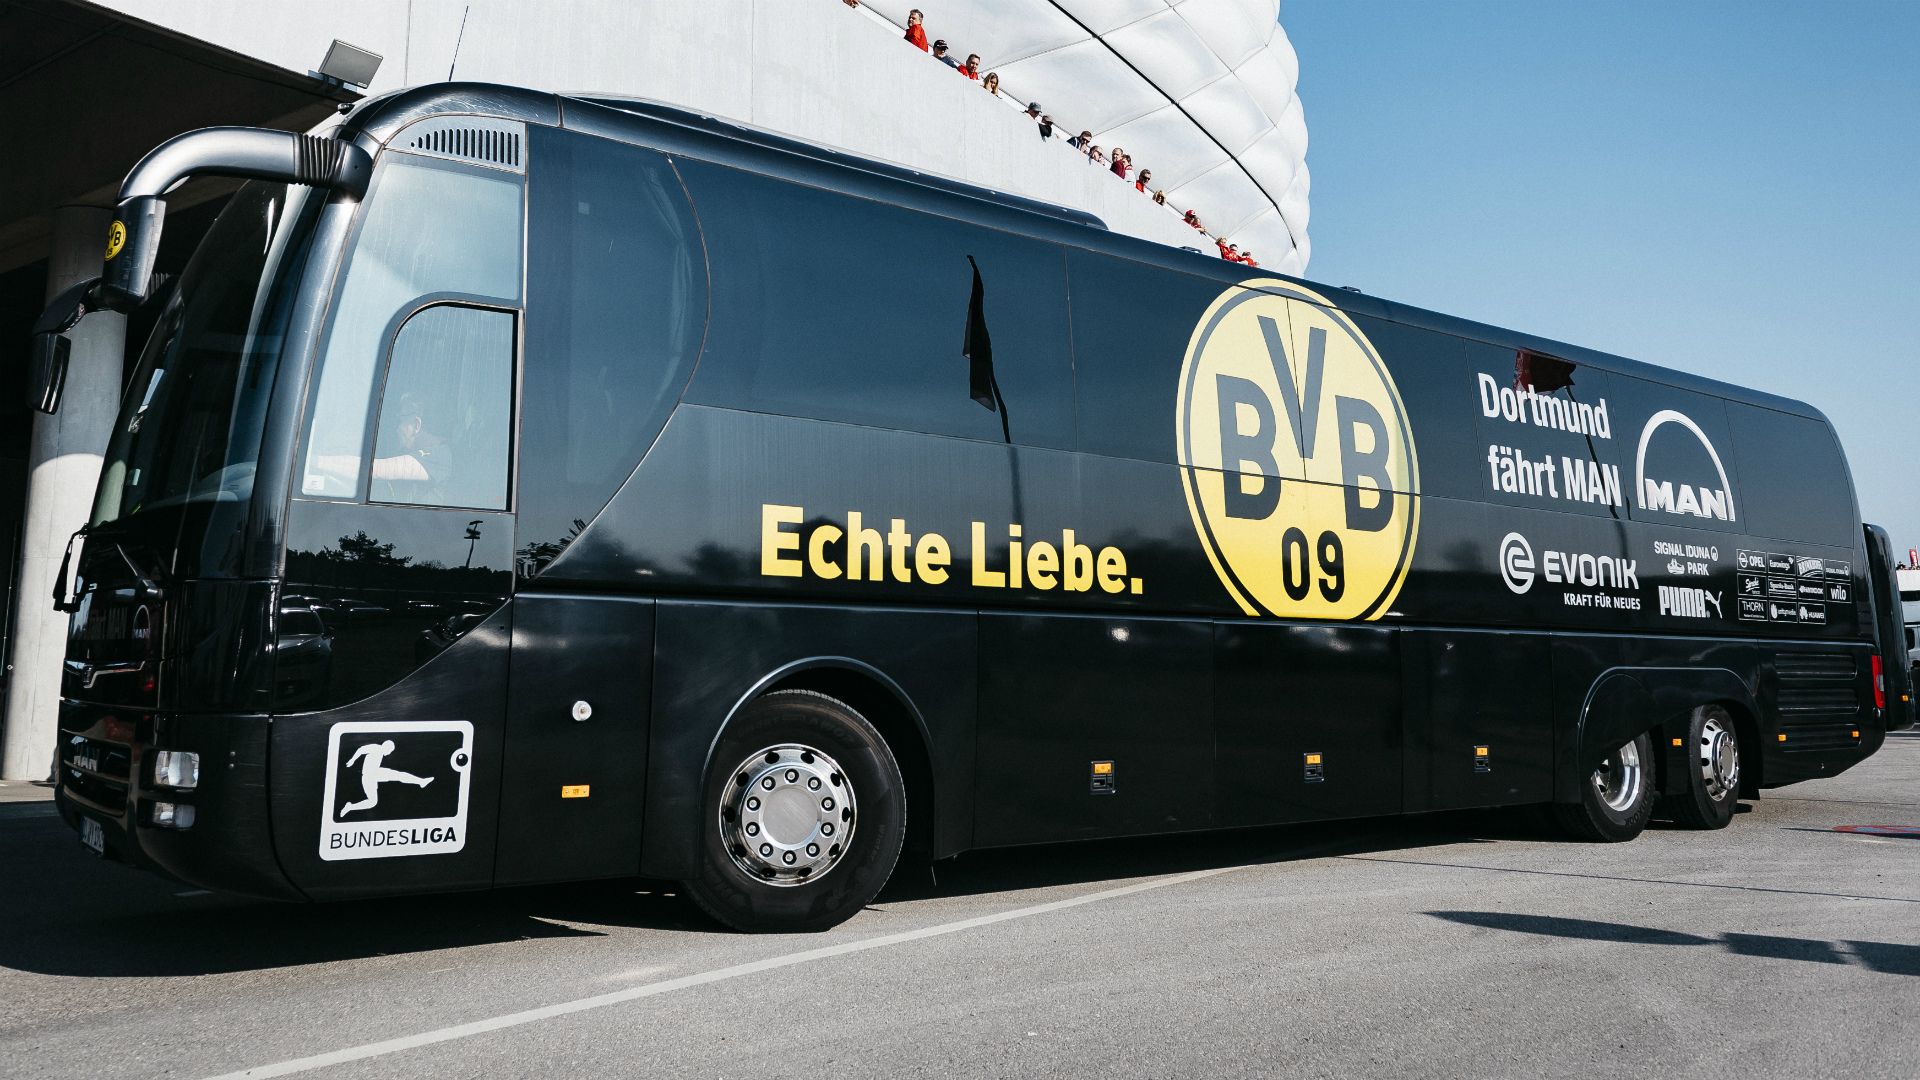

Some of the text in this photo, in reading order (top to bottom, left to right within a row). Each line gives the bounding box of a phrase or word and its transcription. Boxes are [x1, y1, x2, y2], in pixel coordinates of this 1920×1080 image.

[1477, 372, 1612, 440] Dortmund
[1215, 315, 1395, 532] BVB
[1487, 444, 1623, 508] fährt MAN
[1645, 478, 1728, 521] MAN
[760, 503, 1144, 595] Echte Liebe.
[1281, 526, 1346, 604] 09
[1654, 541, 1711, 560] SIGNAL IDUNA
[1749, 555, 1766, 568] OPEL
[1543, 550, 1640, 590] EVONIK
[1687, 561, 1710, 576] PARK
[1563, 592, 1641, 610] KRAFT FÜR NEUES
[1658, 585, 1707, 618] PUMA
[1741, 600, 1764, 612] THORN
[1830, 585, 1847, 601] wilo
[329, 826, 457, 850] BUNDESLIGA
